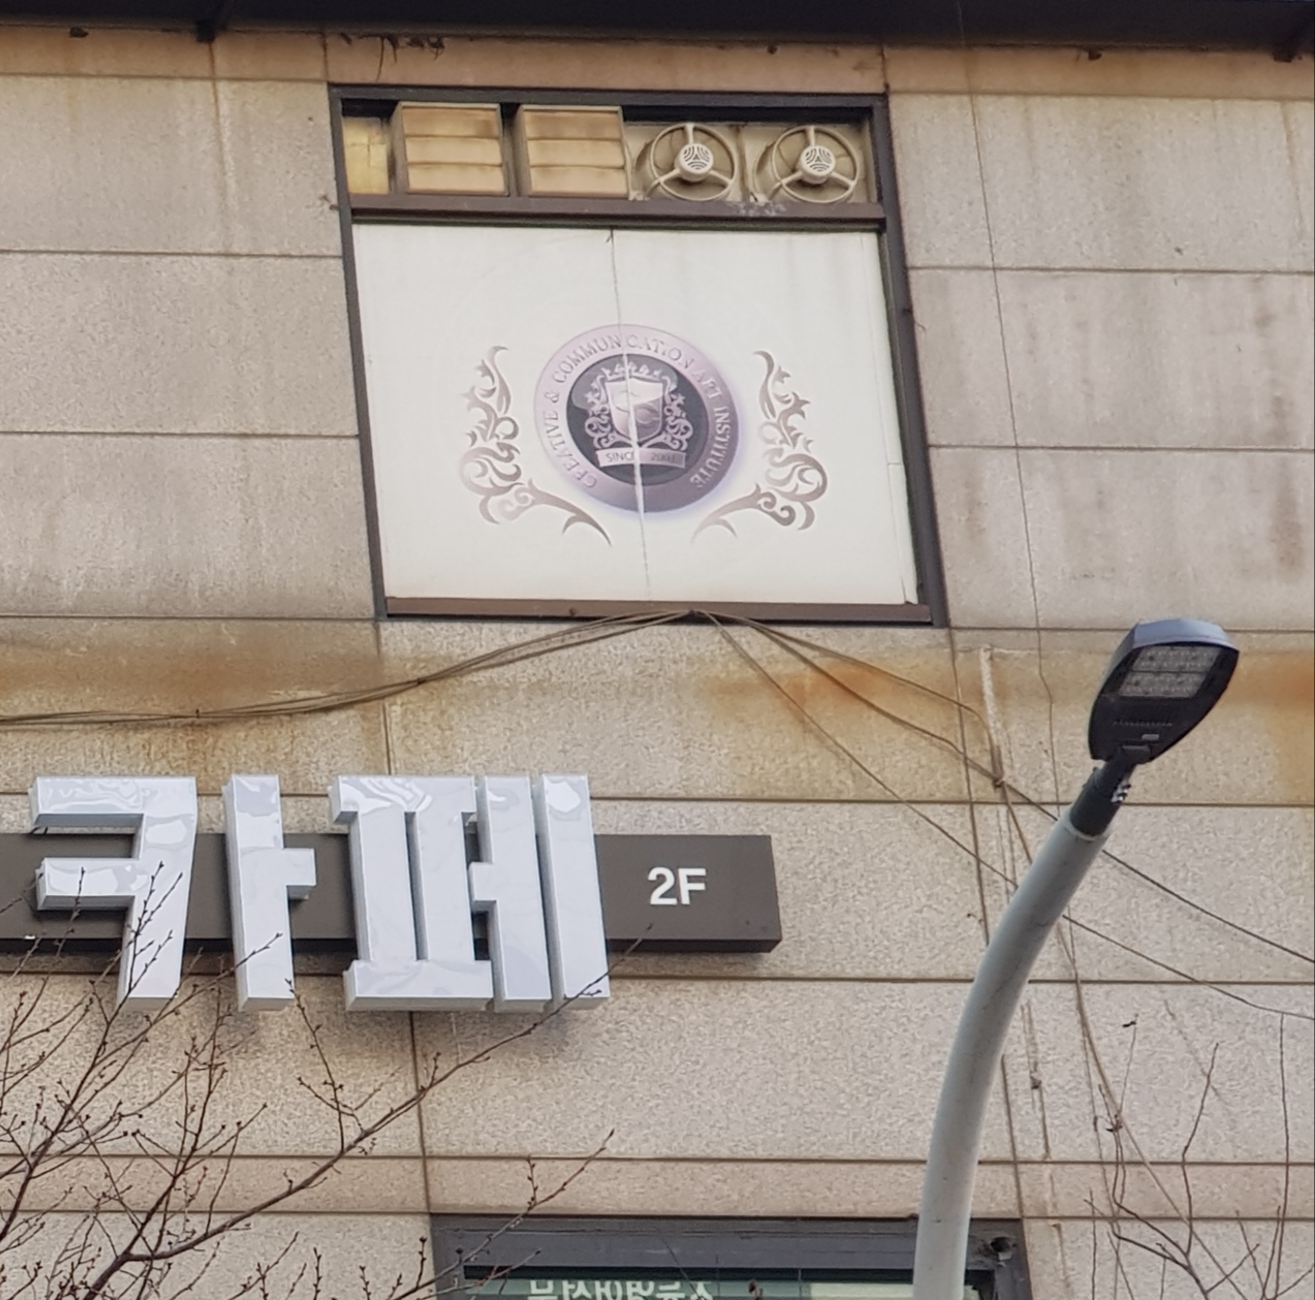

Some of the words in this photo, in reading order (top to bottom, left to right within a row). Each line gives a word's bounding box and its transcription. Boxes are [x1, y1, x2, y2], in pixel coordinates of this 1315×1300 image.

[542, 410, 599, 490] CREATIVE
[689, 406, 733, 490] INSTITUTE
[647, 866, 707, 905] 2F
